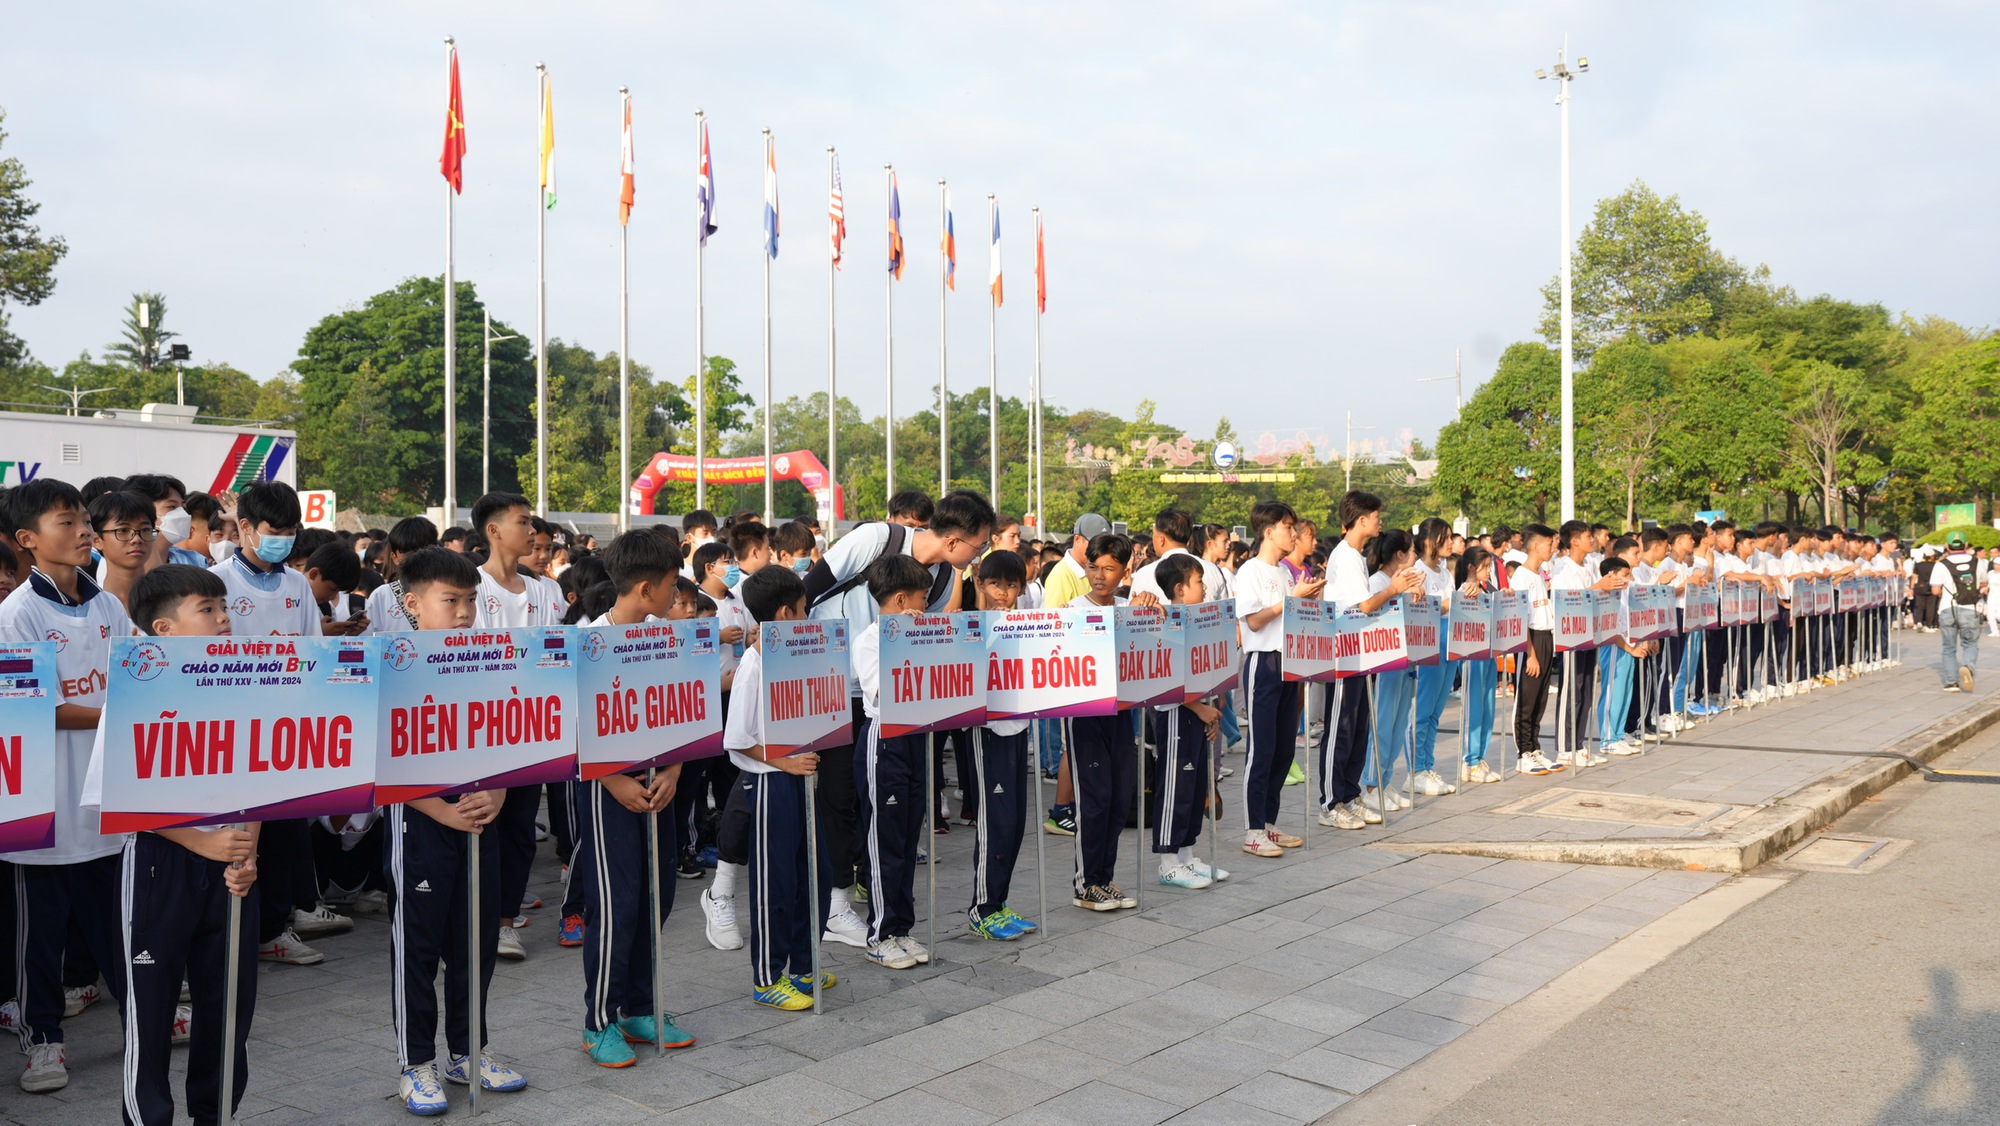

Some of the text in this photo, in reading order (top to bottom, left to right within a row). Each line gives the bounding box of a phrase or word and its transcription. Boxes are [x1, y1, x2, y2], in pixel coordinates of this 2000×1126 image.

[286, 597, 301, 609] BTV
[928, 616, 941, 628] VIỆT
[1006, 610, 1025, 621] GIẢI
[1028, 611, 1045, 622] VIỆT
[1561, 612, 1587, 635] CÀ MAU
[625, 625, 643, 639] GIẢI
[644, 625, 660, 639] VIỆT
[905, 629, 920, 638] CHÀO
[921, 628, 933, 637] NĂM
[946, 625, 959, 636] BTV
[993, 620, 1073, 632] CHÀO NĂM MỚI BTV
[1405, 620, 1422, 646] HÁNH
[1453, 622, 1486, 642] AN GIANG
[444, 632, 469, 647] GIẢI
[471, 632, 494, 648] VIỆT
[613, 636, 686, 654] CHÀO NĂM MỚI BTV
[819, 634, 830, 645] BTV
[1286, 633, 1295, 659] TP.
[1307, 630, 1317, 660] CHÍ
[1318, 636, 1333, 661] MINH
[1363, 627, 1401, 654] DƯƠNG
[206, 639, 297, 659] GIẢI VIỆT DÃ
[427, 645, 528, 664] CHÀO NĂM MỚI BTV
[642, 653, 651, 661] XXV
[667, 651, 678, 659] 2024
[1191, 640, 1228, 676] GIA LAI
[121, 659, 138, 668] BTV
[181, 657, 317, 674] CHÀO NĂM MỚI BTV
[485, 663, 500, 671] NĂM
[501, 663, 517, 671] 2024
[987, 645, 1097, 691] ÂM ĐỒNG
[1119, 639, 1172, 682] ĐẮK LẮK
[216, 676, 234, 686] THỨ
[235, 677, 252, 686] XXV
[260, 675, 280, 685] NĂM
[281, 676, 302, 685] 2024
[891, 659, 974, 703] TÂY NINH
[770, 667, 846, 722] NINH THUẬN
[596, 676, 706, 737] BẮC GIANG
[390, 686, 562, 758] BIÊN PHÒNG
[133, 710, 353, 780] VĨNH LONG
[1165, 871, 1177, 882] CR7
